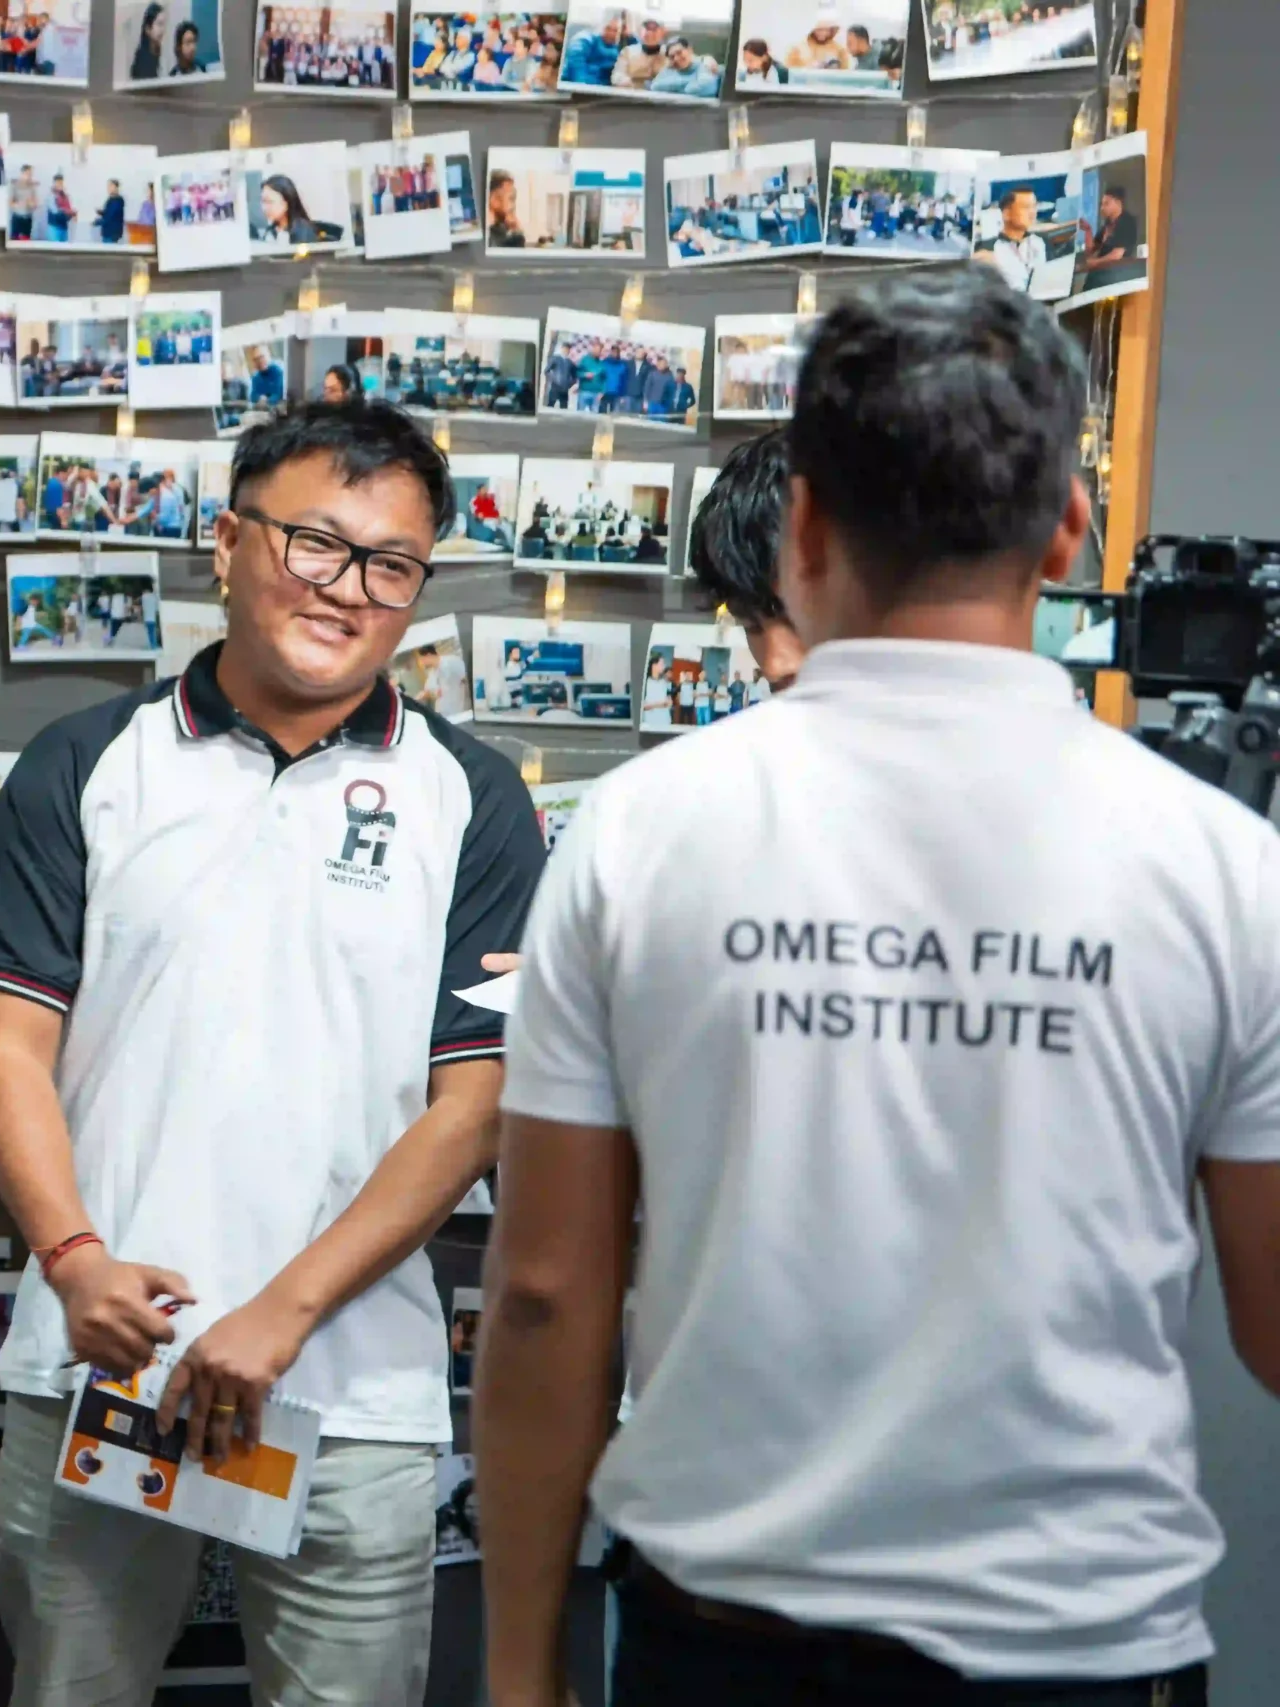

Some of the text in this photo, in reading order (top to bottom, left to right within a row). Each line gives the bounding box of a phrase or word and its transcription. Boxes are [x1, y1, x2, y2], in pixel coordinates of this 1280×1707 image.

[324, 858, 367, 876] OMEGA
[724, 918, 1114, 987] OMEGA FILM
[754, 990, 1076, 1054] INSTITUTE
